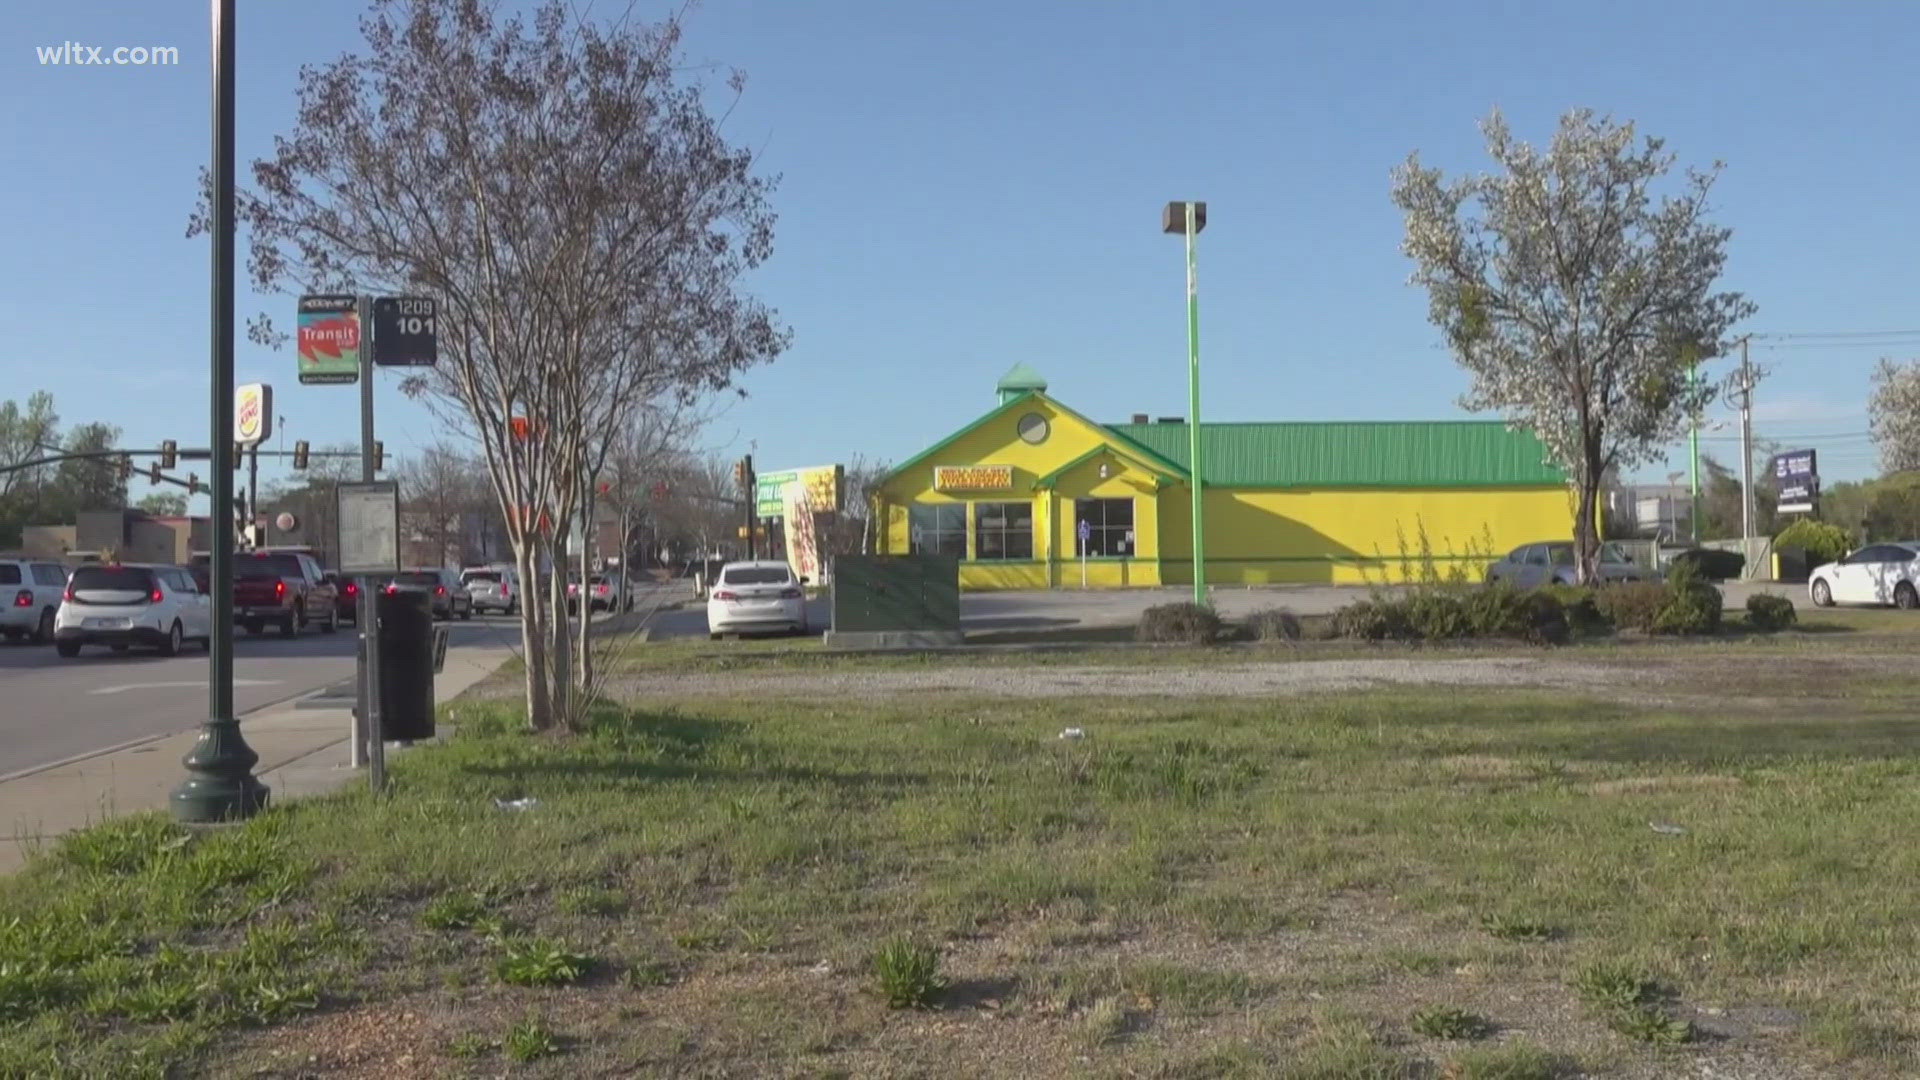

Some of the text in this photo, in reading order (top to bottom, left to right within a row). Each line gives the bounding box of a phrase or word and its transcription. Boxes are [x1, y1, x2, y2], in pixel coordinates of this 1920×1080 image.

[396, 300, 432, 315] 1209
[303, 326, 354, 340] Transit
[396, 317, 434, 335] 101
